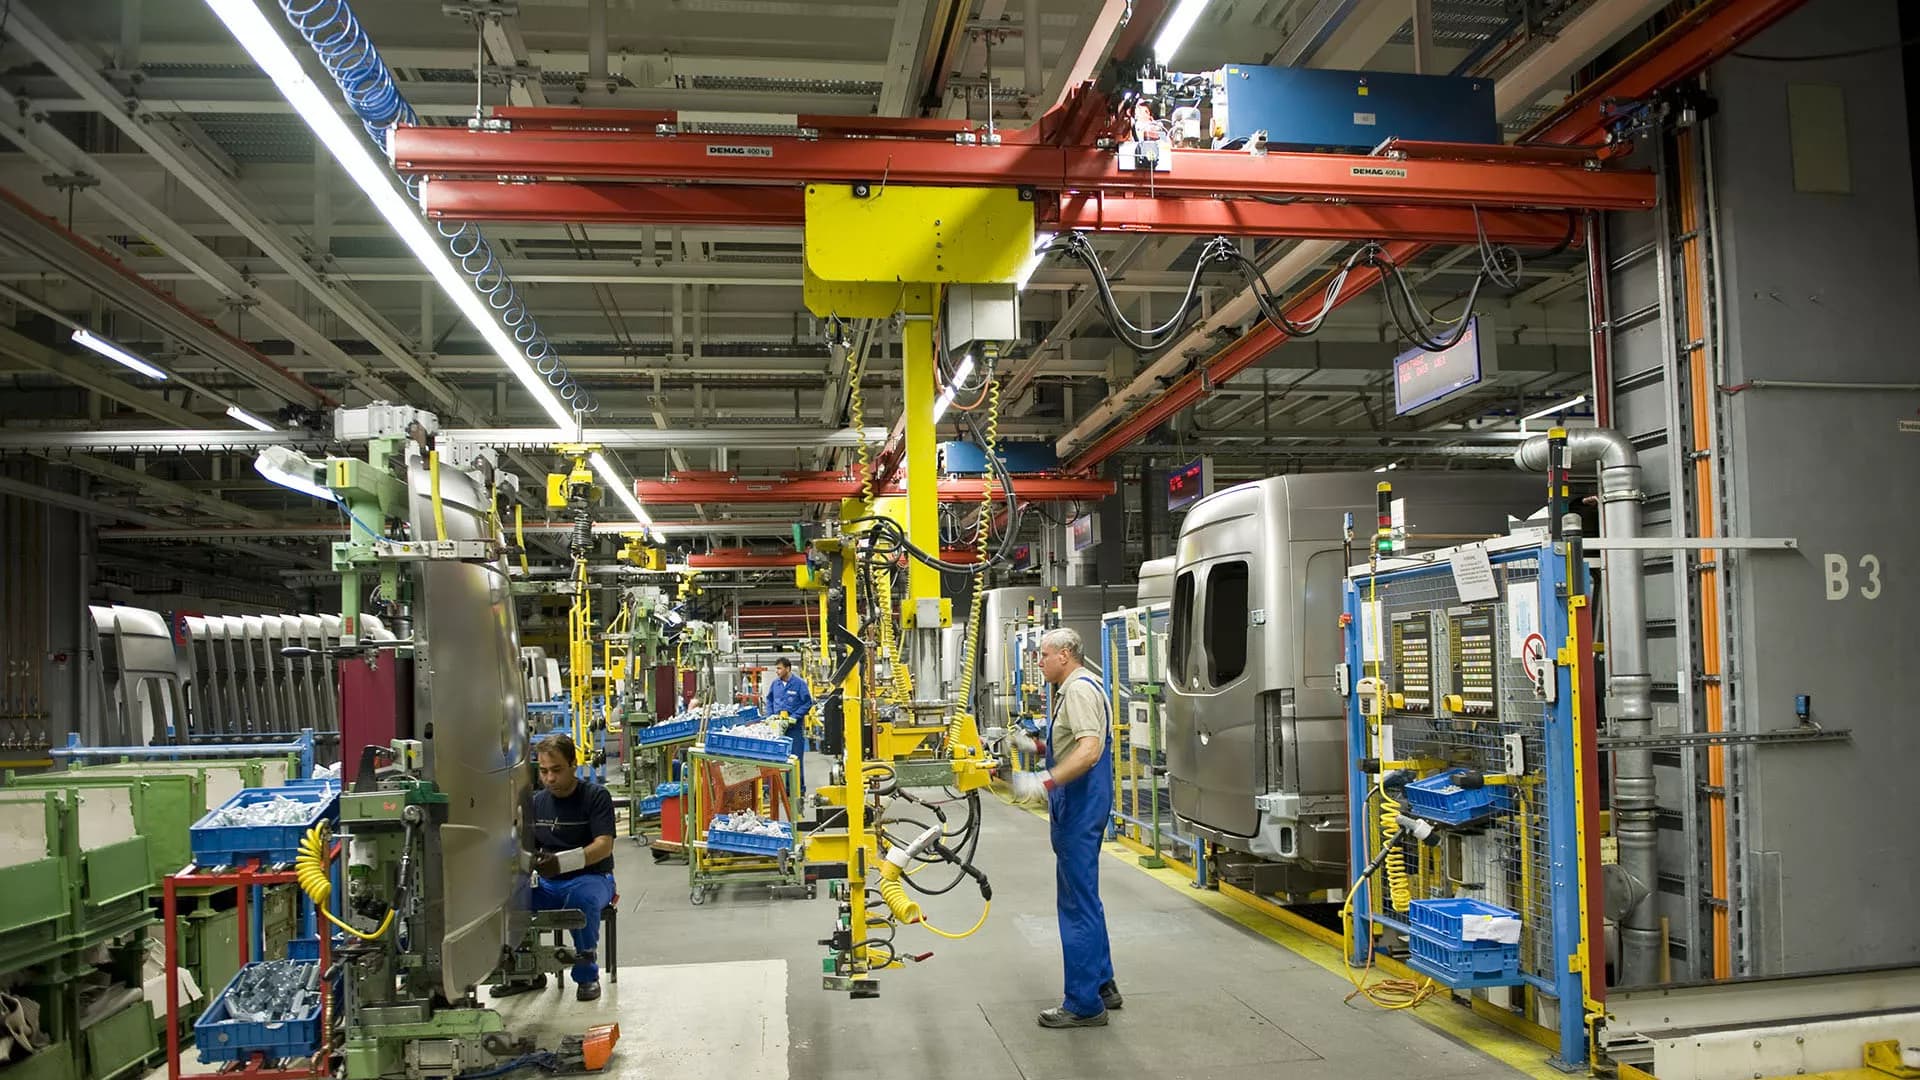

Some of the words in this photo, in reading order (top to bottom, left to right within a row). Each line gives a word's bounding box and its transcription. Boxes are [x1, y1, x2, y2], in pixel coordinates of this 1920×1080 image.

[339, 462, 344, 486] 1
[1824, 553, 1849, 600] B
[1859, 553, 1881, 600] 3
